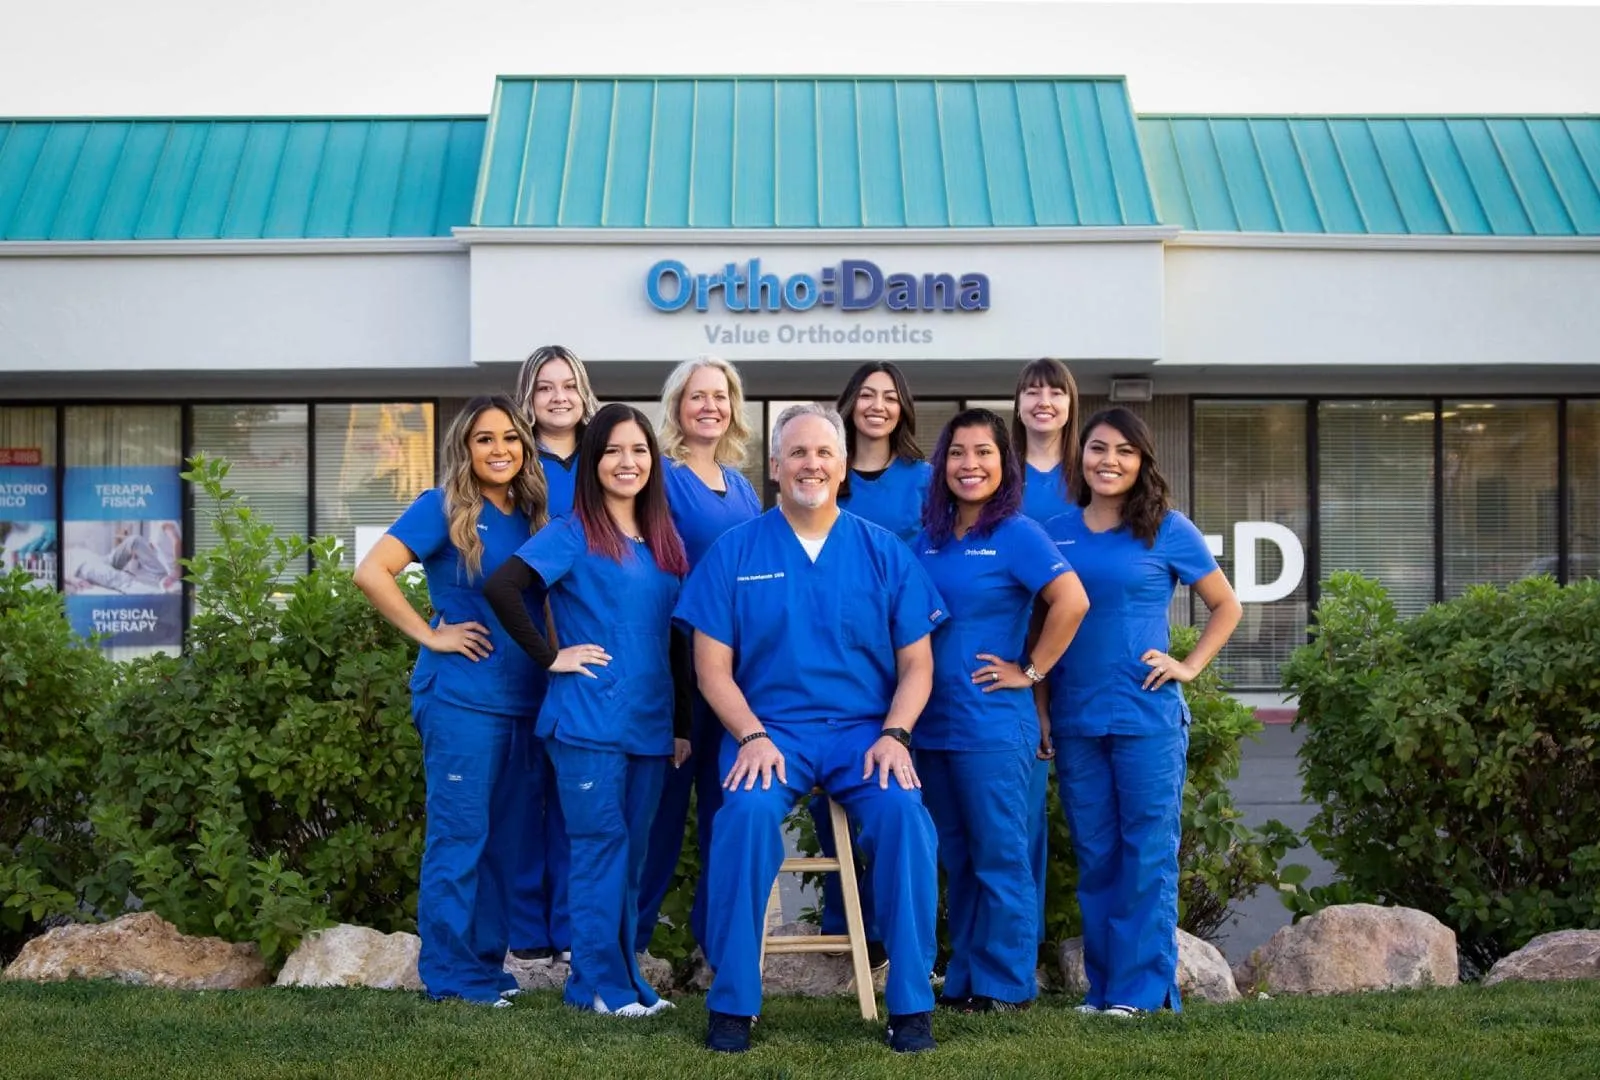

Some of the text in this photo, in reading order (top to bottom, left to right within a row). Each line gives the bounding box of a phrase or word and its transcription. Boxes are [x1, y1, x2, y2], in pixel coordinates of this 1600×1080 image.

[704, 323, 933, 344] Value Orthodontics
[95, 484, 154, 496] TERAPIA
[92, 608, 158, 620] PHYSICAL
[95, 620, 156, 632] THERAPY
